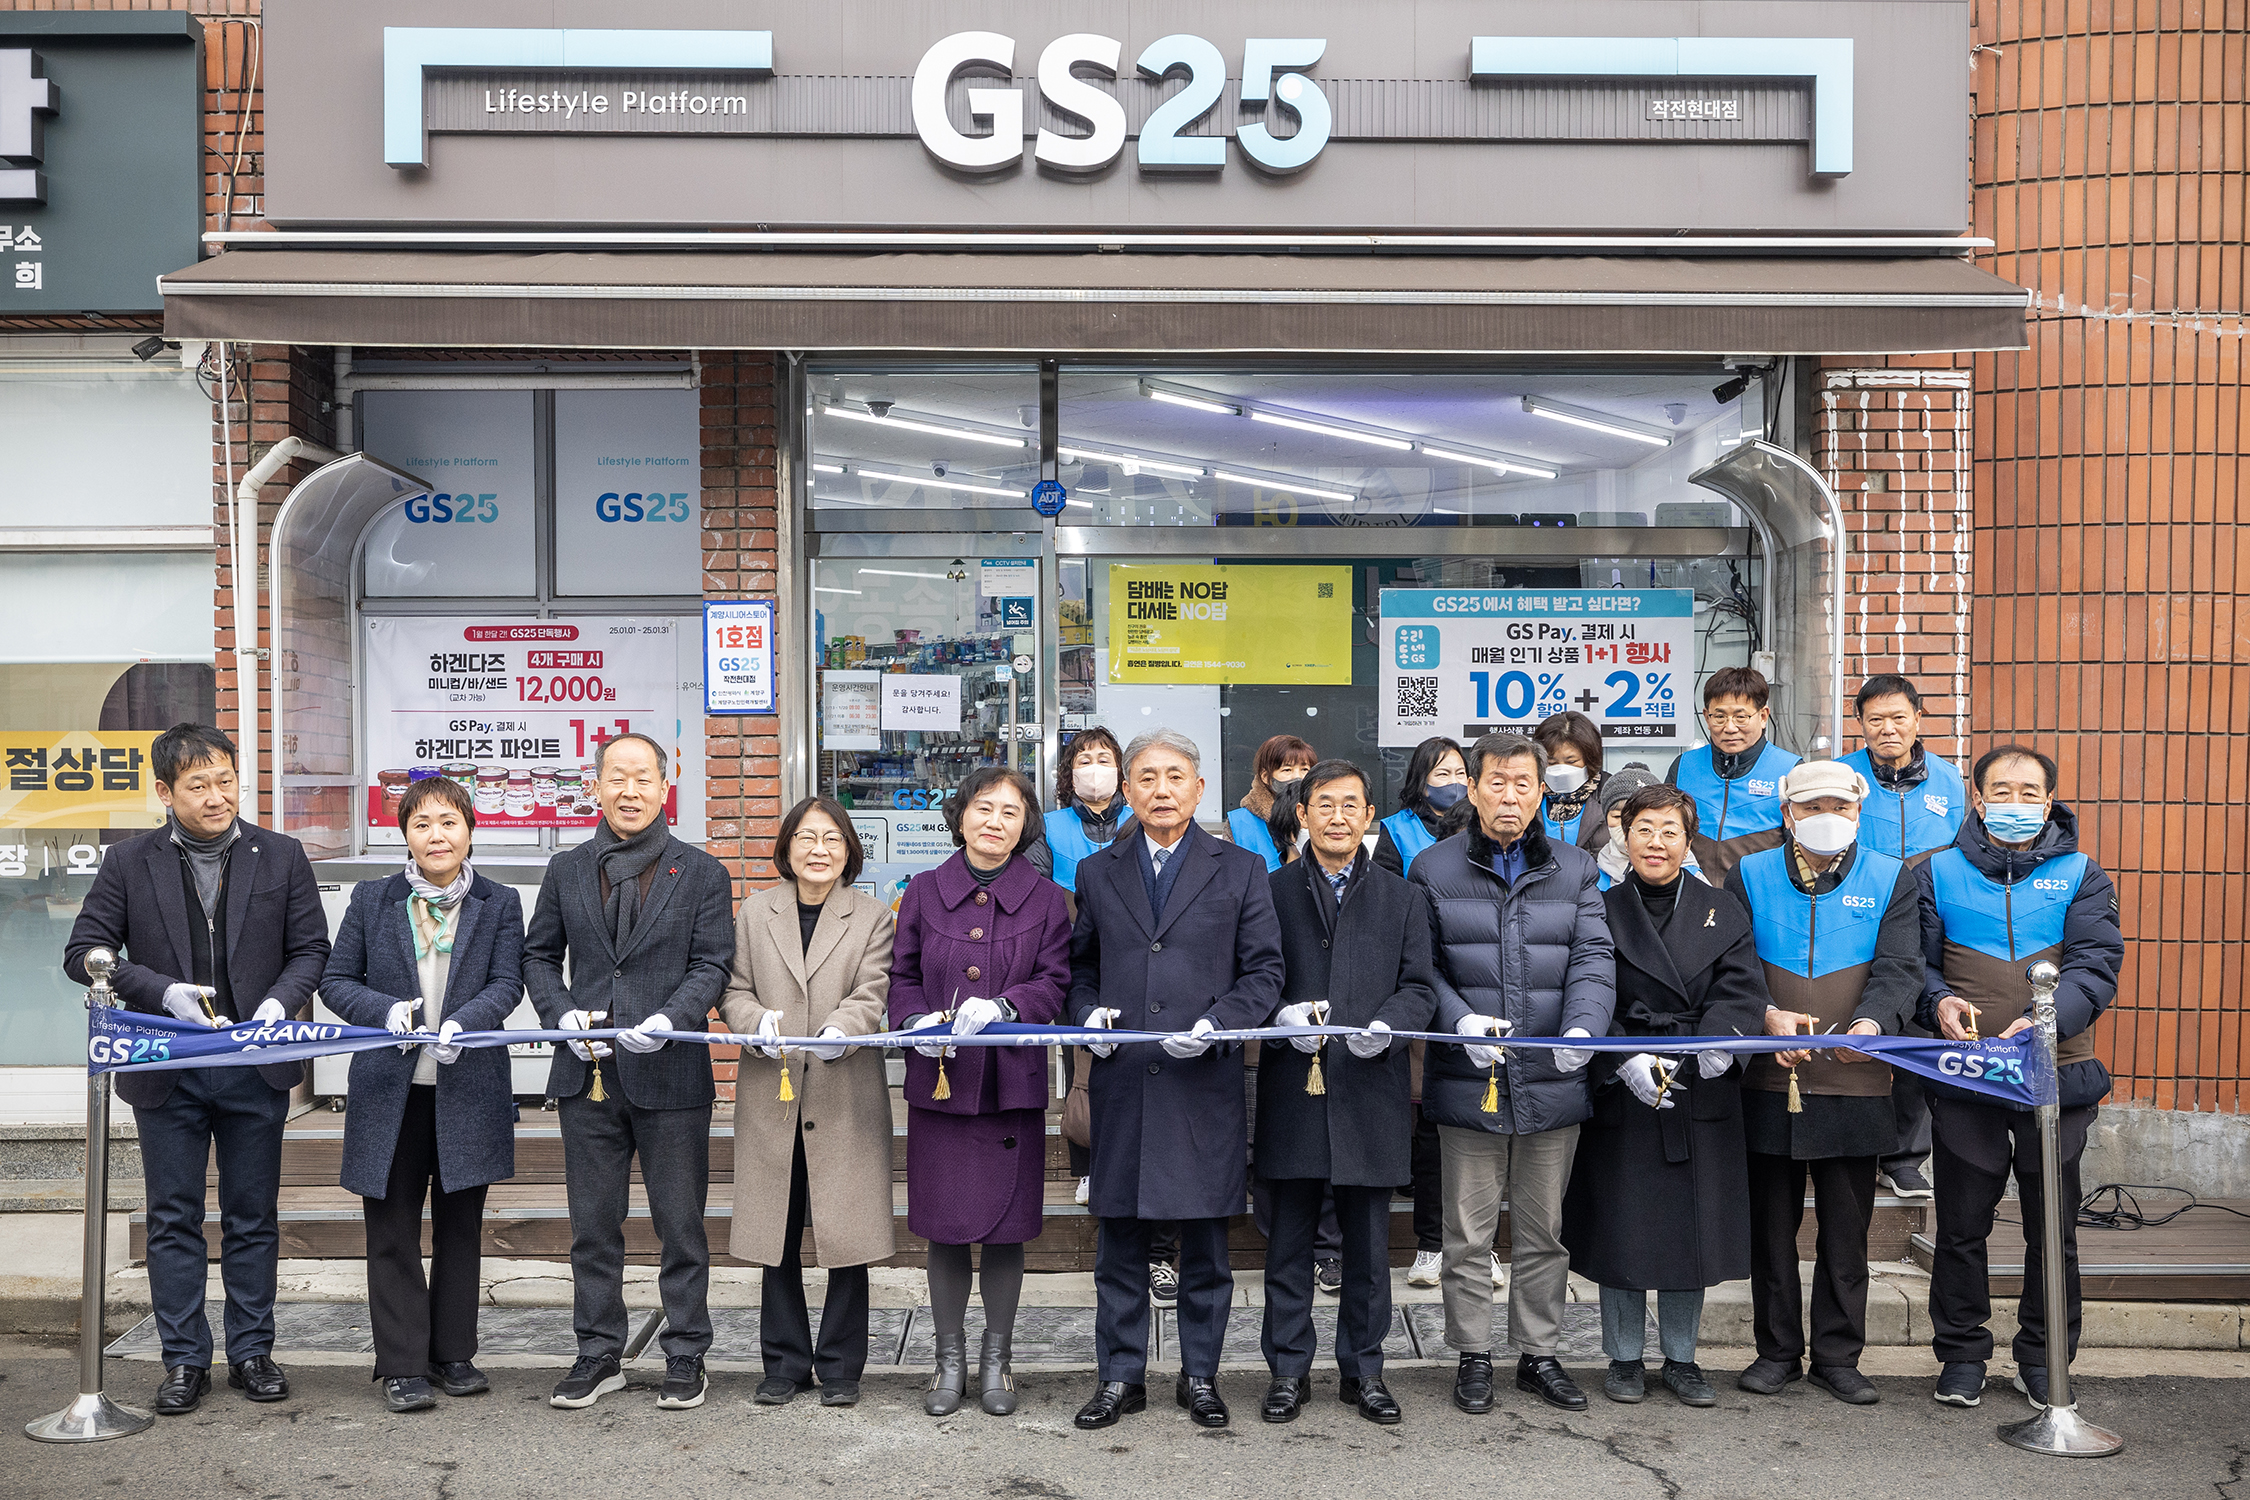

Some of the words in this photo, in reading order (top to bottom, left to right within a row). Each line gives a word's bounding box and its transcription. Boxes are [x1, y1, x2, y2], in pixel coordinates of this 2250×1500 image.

[484, 89, 609, 119] Lifestyle
[622, 90, 748, 115] Platform
[912, 31, 1332, 174] GS25
[1652, 98, 1738, 120] 작전현대점
[15, 262, 42, 290] 희
[406, 457, 450, 468] Lifestyle
[453, 457, 498, 467] Platform
[597, 456, 641, 467] Lifestyle
[645, 456, 690, 466] Platform
[1037, 492, 1060, 503] ADT
[404, 493, 499, 523] GS25
[595, 492, 690, 523] GS25
[1127, 581, 1174, 599] 담배는
[1180, 581, 1228, 600] NO답
[1127, 602, 1177, 620] 대세는
[1180, 602, 1228, 621] NO담
[1517, 596, 1548, 612] 혜택
[1553, 596, 1583, 612] 받고
[1587, 596, 1641, 612] 싶다면?
[710, 610, 768, 619] 계양시니어스토어
[472, 629, 482, 638] 1월
[510, 629, 536, 638] GS25
[643, 626, 669, 634] 25.01.31
[716, 625, 763, 648] 1호점
[1506, 623, 1534, 640] GS
[1581, 623, 1614, 640] 결제
[1619, 623, 1635, 640] 시
[530, 653, 553, 666] 4개
[557, 653, 583, 666] 구매
[587, 653, 600, 666] 시
[1411, 654, 1426, 663] GS
[1471, 647, 1505, 664] 매월
[1510, 647, 1542, 664] 인기
[1547, 647, 1579, 664] 상품
[1584, 644, 1618, 664] 1+1
[1625, 642, 1671, 665] 행사
[429, 653, 506, 673] 하겐다즈
[718, 657, 760, 672] GS25
[428, 678, 507, 690] 미니컵/바/샌드
[516, 676, 617, 703] 12,000원
[832, 683, 874, 692] 운영시간안내
[468, 693, 486, 702] 가능)
[910, 689, 951, 698] 당겨주세요!
[1469, 670, 1566, 719] 10%
[1604, 670, 1674, 718] 2%
[901, 705, 942, 714] 감사합니다.
[1644, 702, 1675, 718] 적립
[449, 720, 467, 732] GS
[496, 721, 515, 732] 결제
[518, 721, 527, 732] 시
[1613, 725, 1631, 735] 계좌
[1634, 725, 1652, 735] 연동
[1654, 725, 1664, 735] 시
[415, 739, 494, 760] 하겐다즈
[500, 738, 561, 759] 파인트
[1748, 779, 1775, 790] GS25
[1923, 794, 1948, 806] GS25
[2033, 879, 2069, 891] GS25
[1842, 895, 1875, 908] GS25
[91, 1020, 132, 1034] Lifestyle
[136, 1024, 177, 1039] Platform
[230, 1024, 342, 1042] GRAND
[89, 1035, 171, 1064] GS25
[1937, 1051, 2025, 1085] GS25
